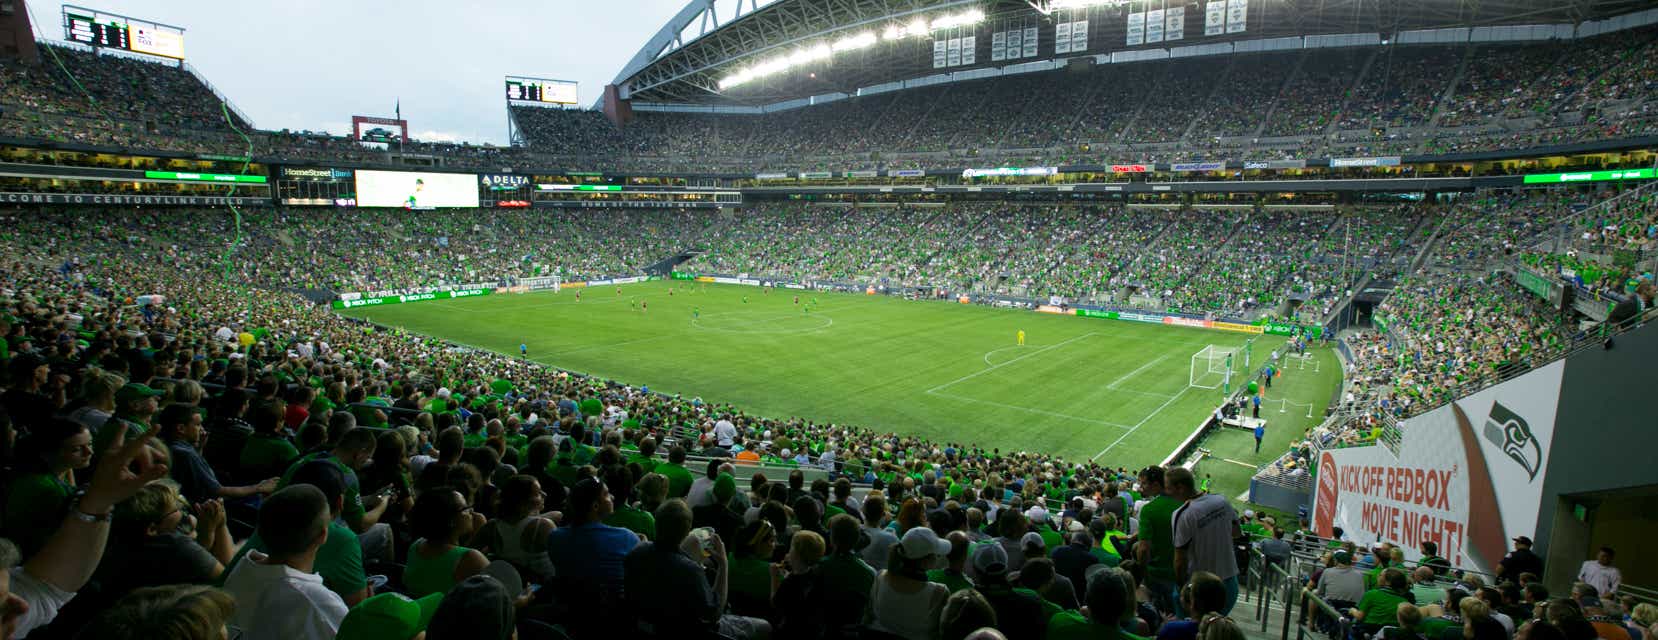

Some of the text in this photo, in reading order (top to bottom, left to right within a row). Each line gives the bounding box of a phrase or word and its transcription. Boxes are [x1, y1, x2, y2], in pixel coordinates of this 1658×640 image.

[1245, 161, 1268, 169] Safeco
[285, 168, 331, 177] HomeStreet
[493, 175, 530, 184] DELTA
[64, 195, 83, 203] TO
[93, 196, 197, 205] CENTURYLINK
[1340, 465, 1360, 493] KICK
[1362, 466, 1384, 496] OFF
[1386, 467, 1451, 512] REDBOX
[1361, 501, 1399, 542] MOVIE
[1402, 510, 1463, 566] NIGHT!
